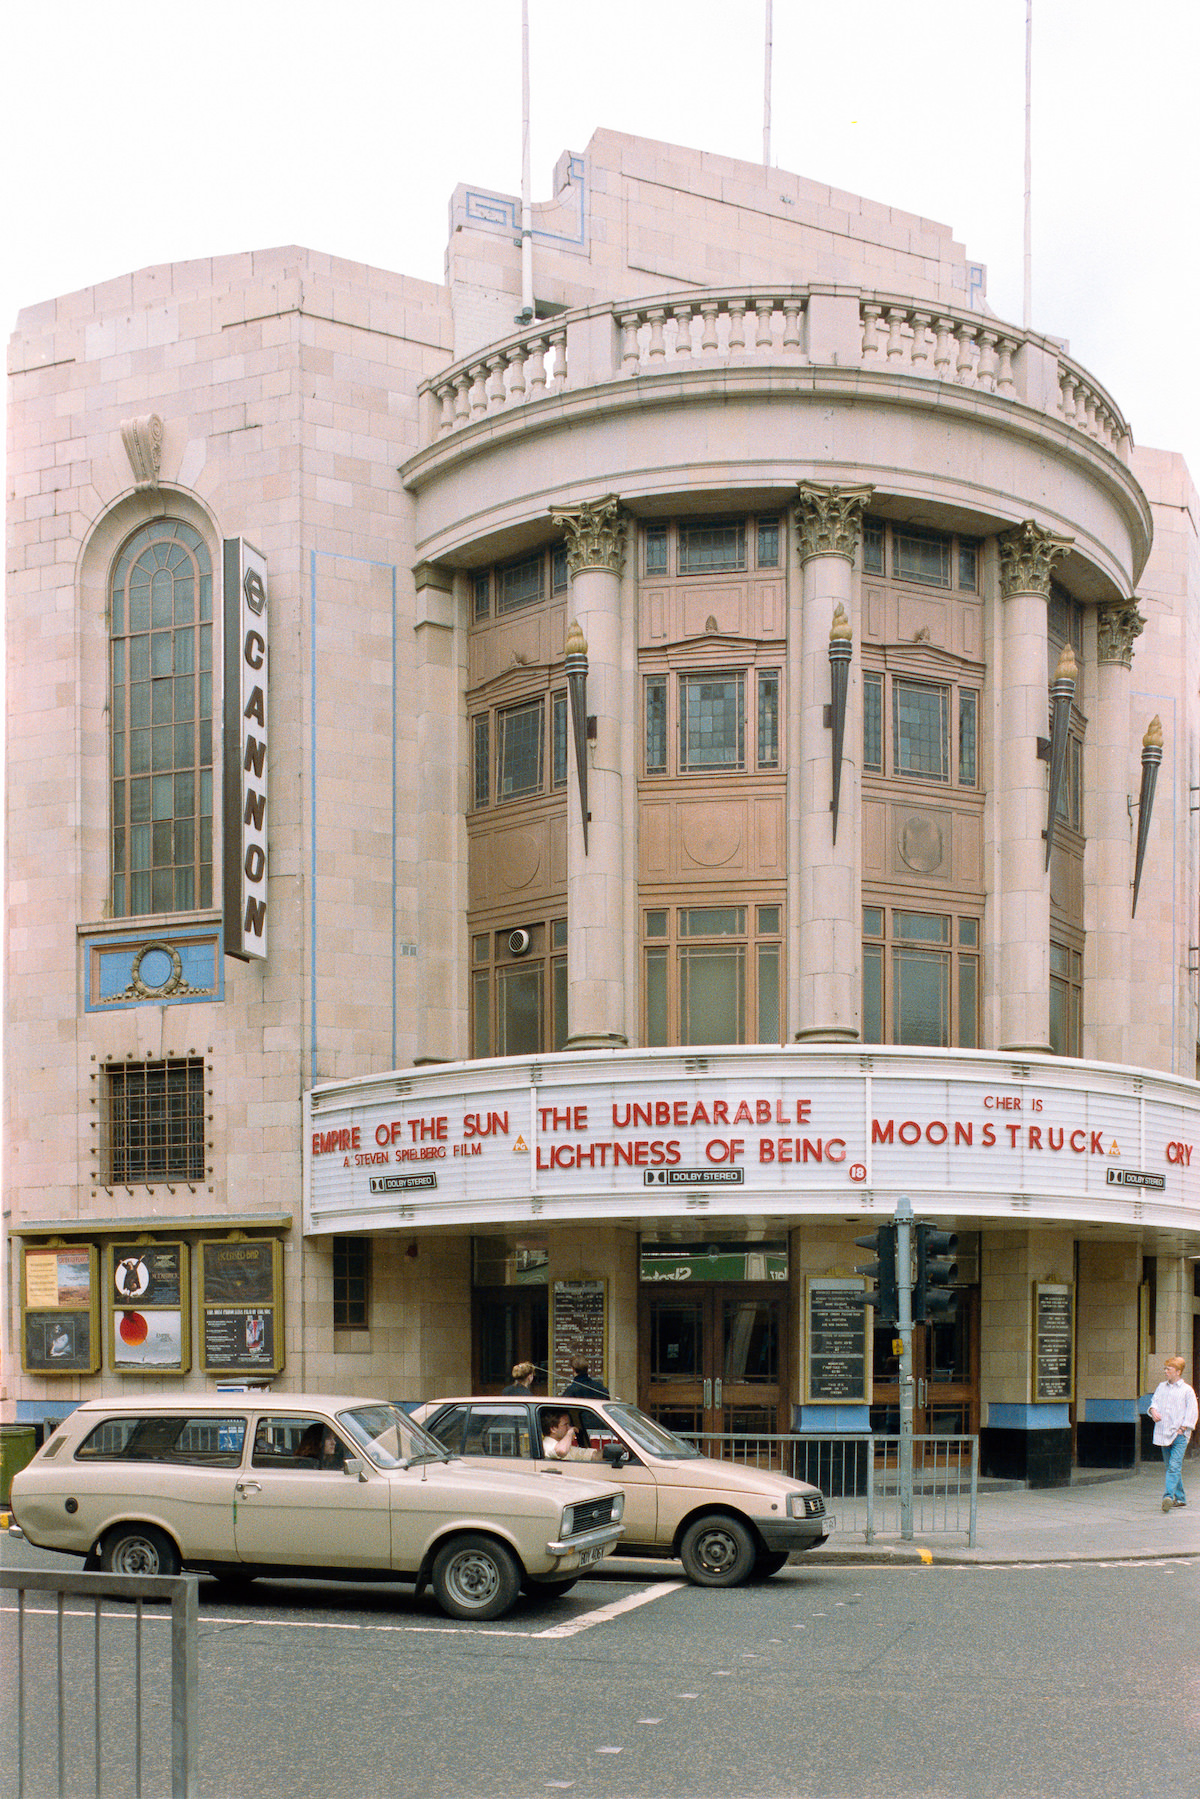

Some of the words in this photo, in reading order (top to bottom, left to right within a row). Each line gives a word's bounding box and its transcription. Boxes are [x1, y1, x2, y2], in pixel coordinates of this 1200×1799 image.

[244, 629, 267, 938] CANNON
[538, 1106, 589, 1132] THE
[611, 1099, 812, 1128] UNBEARABLE
[984, 1096, 1022, 1111] CHER
[1031, 1098, 1044, 1113] IS
[312, 1126, 361, 1155] EMPIRE
[375, 1121, 401, 1147] OF
[407, 1116, 448, 1142] THE
[463, 1110, 509, 1138] SUN
[872, 1119, 1105, 1155] MOONSTRUCK
[343, 1156, 350, 1168] A
[355, 1152, 389, 1166] STEVEN
[395, 1146, 446, 1162] SPIELBERG
[453, 1143, 482, 1157] FILM
[515, 1143, 526, 1151] PG
[536, 1140, 682, 1171] LIGHTNESS
[705, 1139, 745, 1164] OF
[759, 1138, 847, 1163] BEING
[1165, 1141, 1193, 1168] CRY
[387, 1179, 407, 1188] DOLBY
[407, 1176, 432, 1187] STEREO
[672, 1173, 702, 1181] DOLBY
[703, 1172, 738, 1180] STEREO
[851, 1166, 865, 1178] 18
[1126, 1174, 1145, 1184] DOLBY
[1144, 1177, 1163, 1186] STEREO
